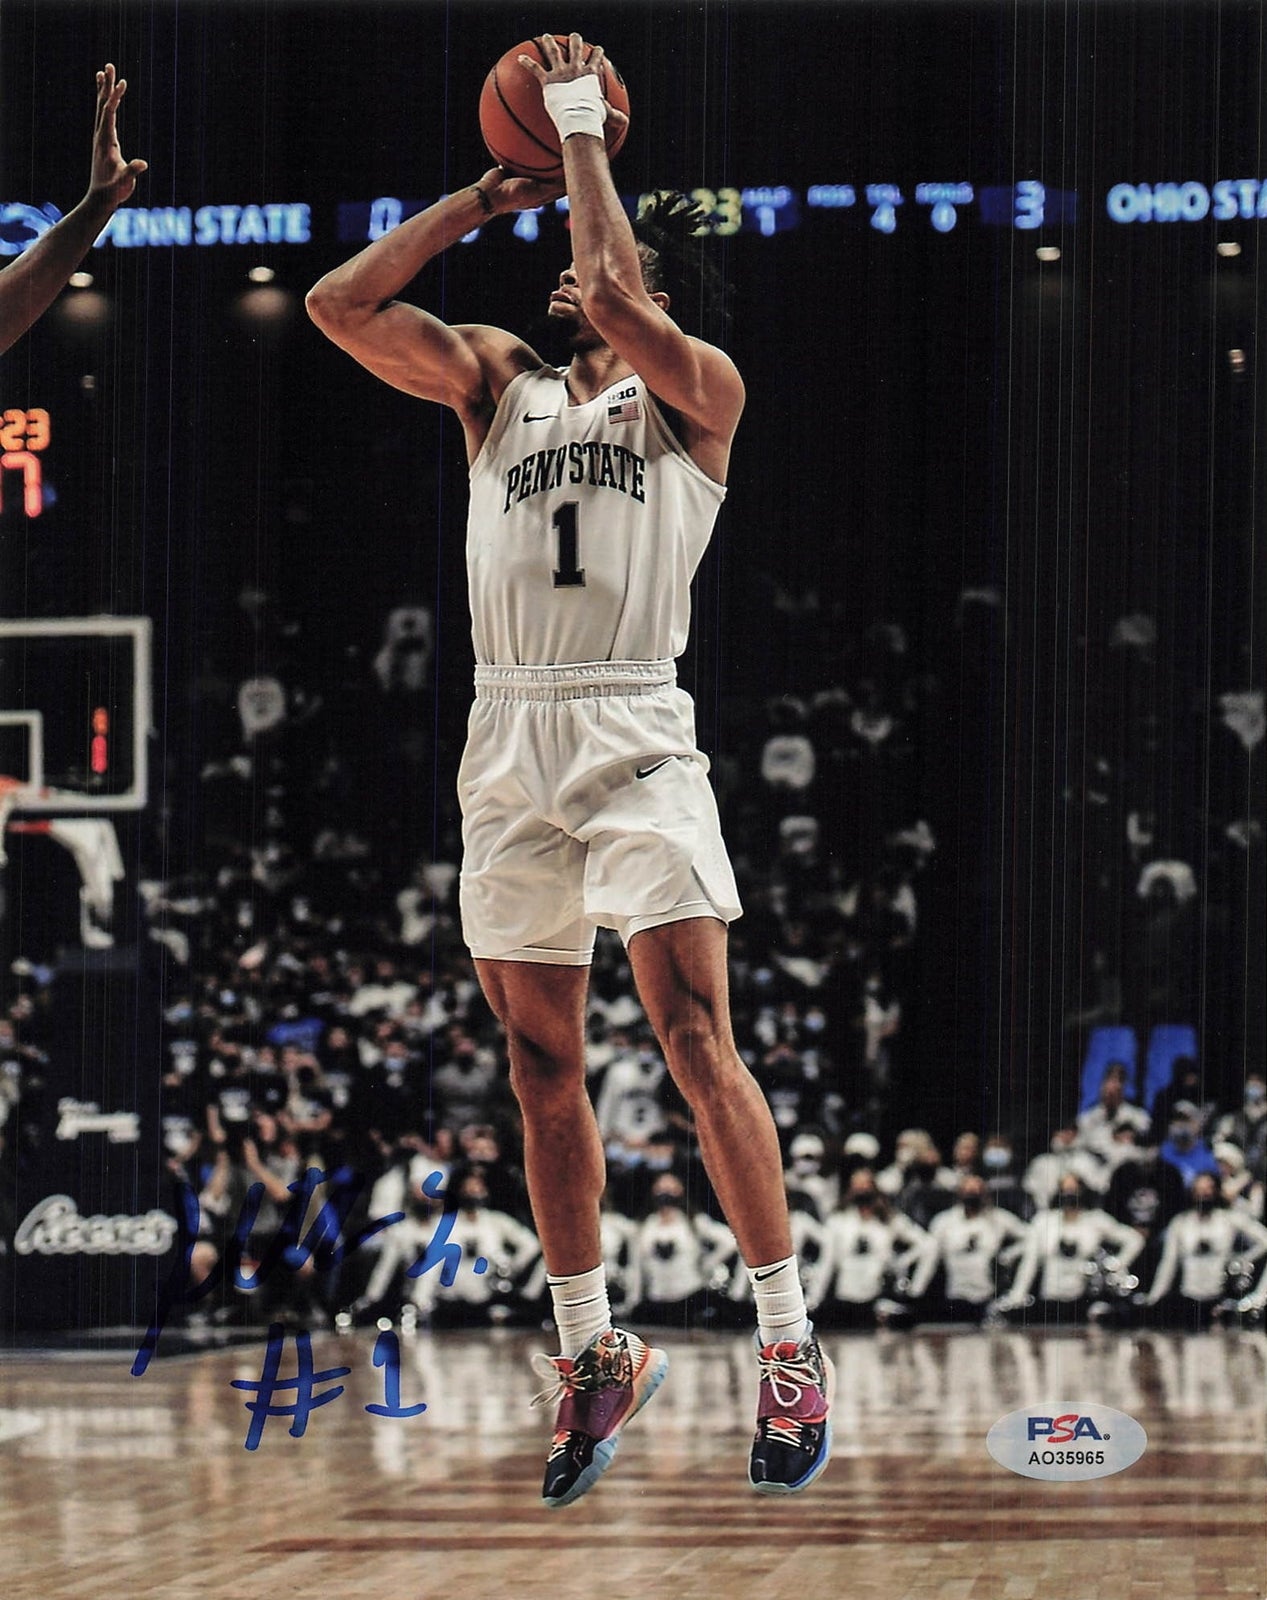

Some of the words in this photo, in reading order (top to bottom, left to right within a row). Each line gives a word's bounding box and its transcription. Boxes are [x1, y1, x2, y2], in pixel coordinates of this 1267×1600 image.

[195, 203, 312, 246] STATE
[1014, 180, 1046, 230] 3
[1107, 181, 1210, 224] OHIO
[504, 444, 567, 514] PENN
[569, 441, 646, 504] STATE
[552, 500, 587, 589] 1
